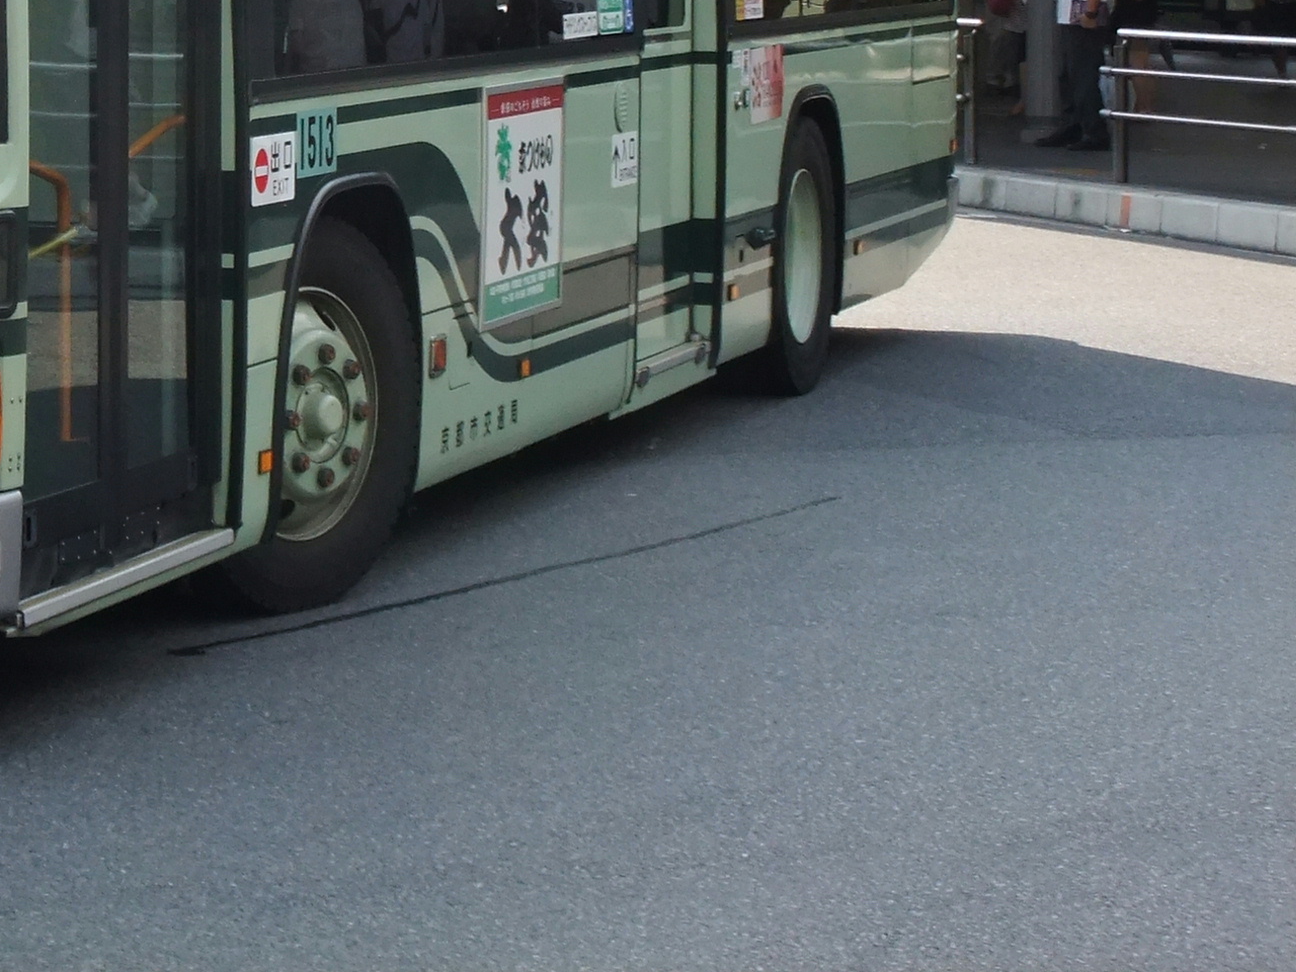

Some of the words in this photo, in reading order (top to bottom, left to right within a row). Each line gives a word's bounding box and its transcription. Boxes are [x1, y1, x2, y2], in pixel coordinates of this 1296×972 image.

[270, 140, 292, 172] 出口
[300, 115, 334, 170] 1513
[620, 137, 636, 163] 入口
[272, 177, 289, 196] EXIT
